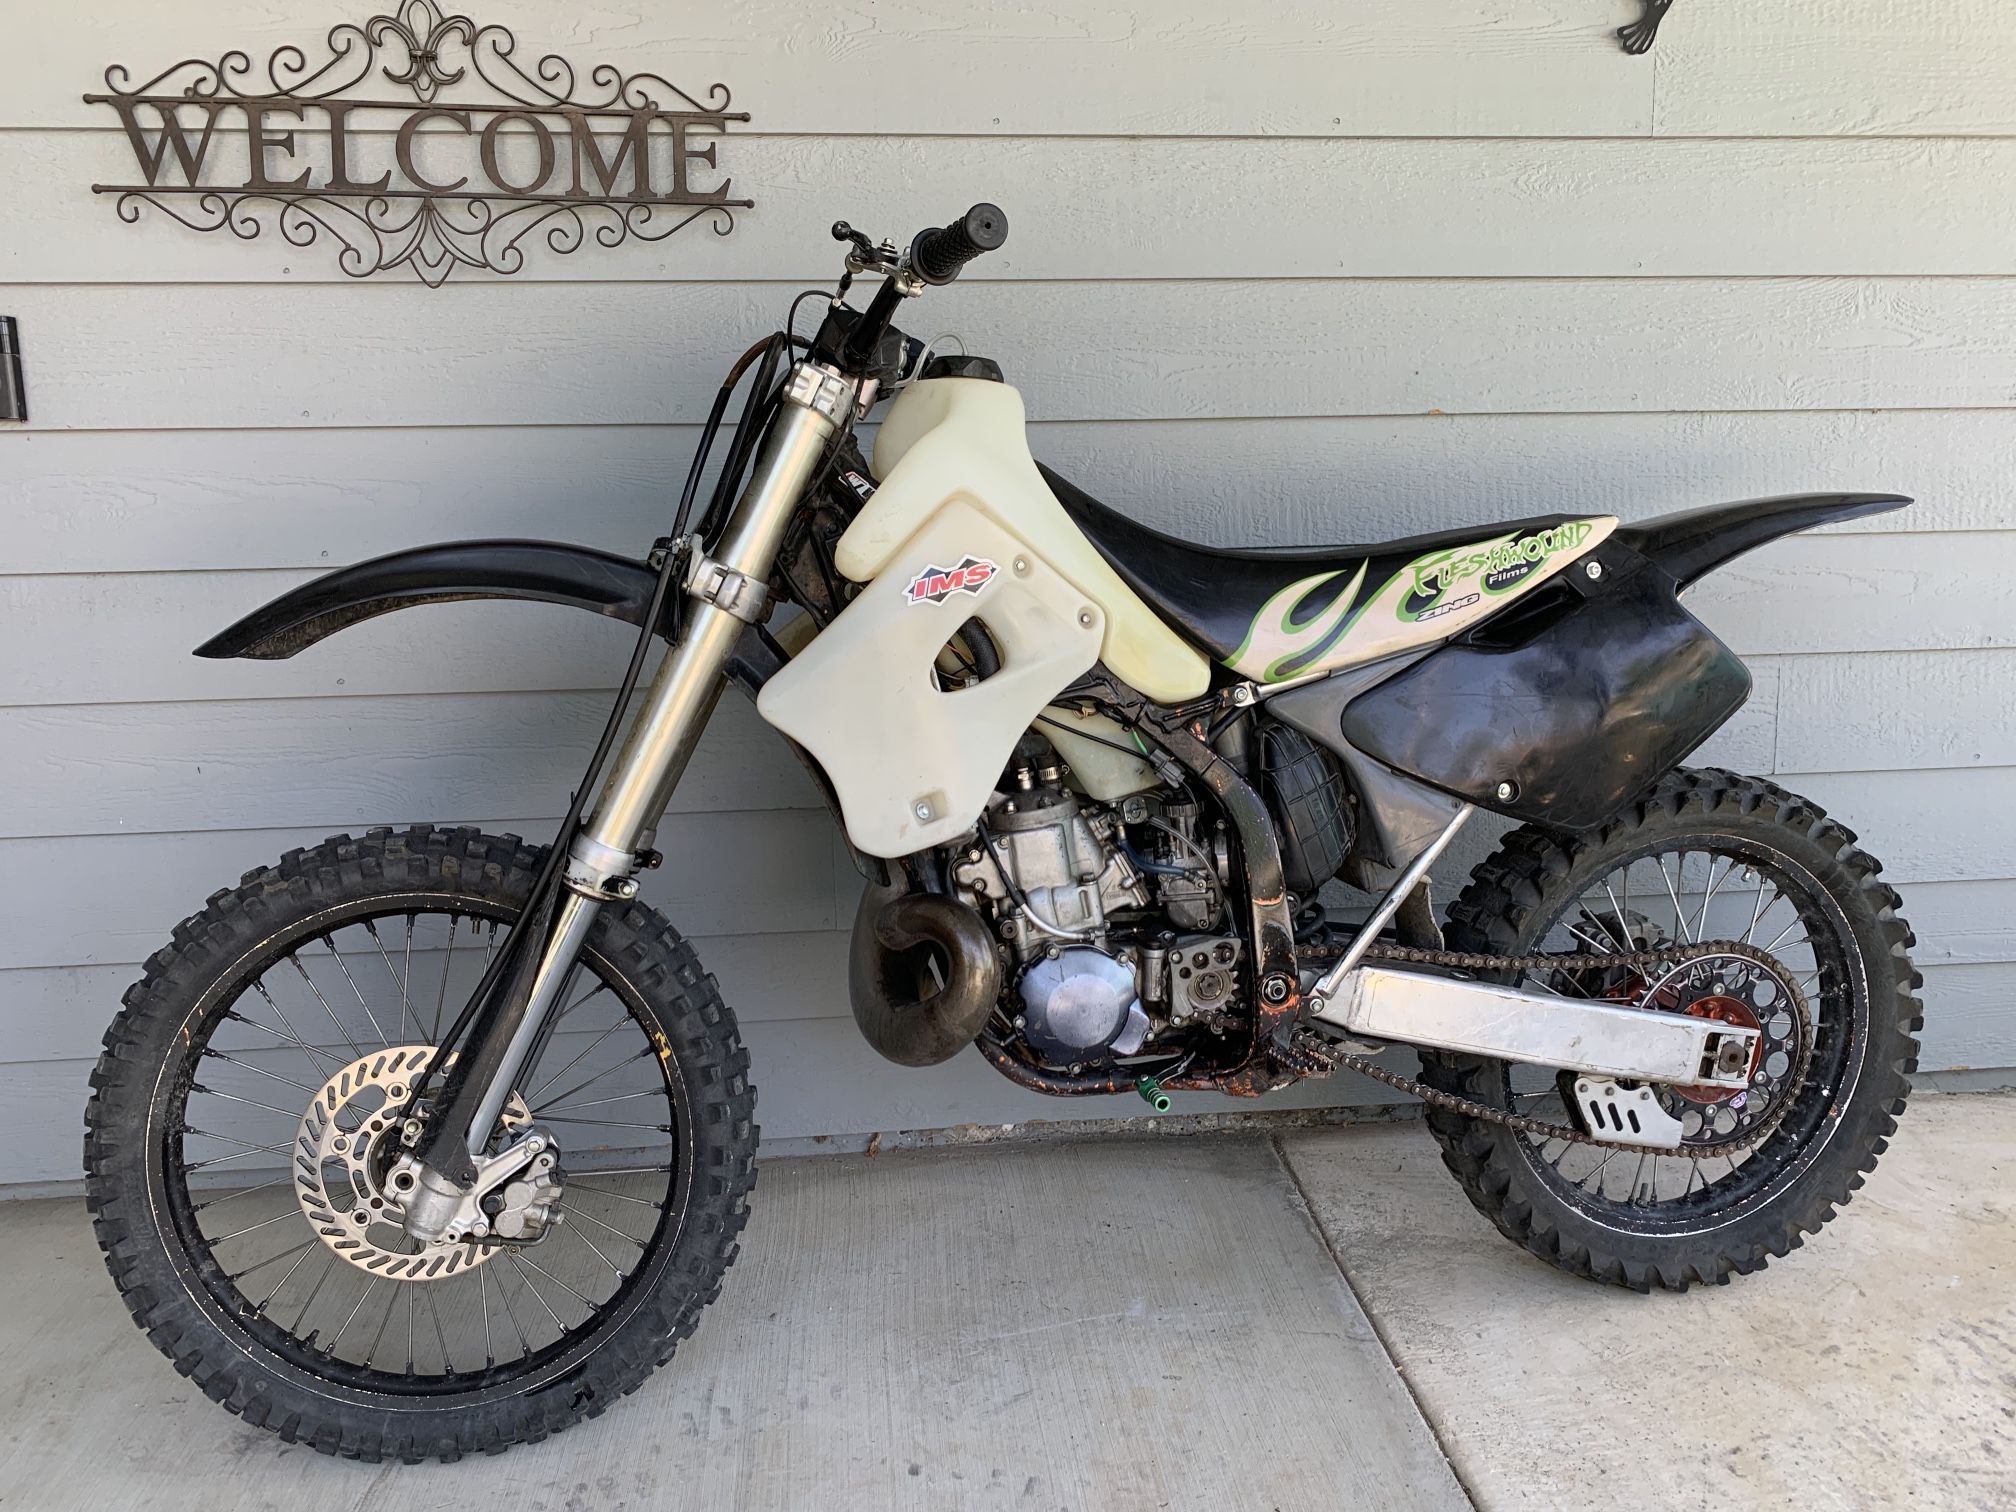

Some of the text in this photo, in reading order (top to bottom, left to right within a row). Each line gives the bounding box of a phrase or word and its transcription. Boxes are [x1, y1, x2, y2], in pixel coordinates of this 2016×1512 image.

[108, 101, 732, 200] WELCOME
[913, 563, 993, 600] IMS
[1489, 566, 1529, 585] Films
